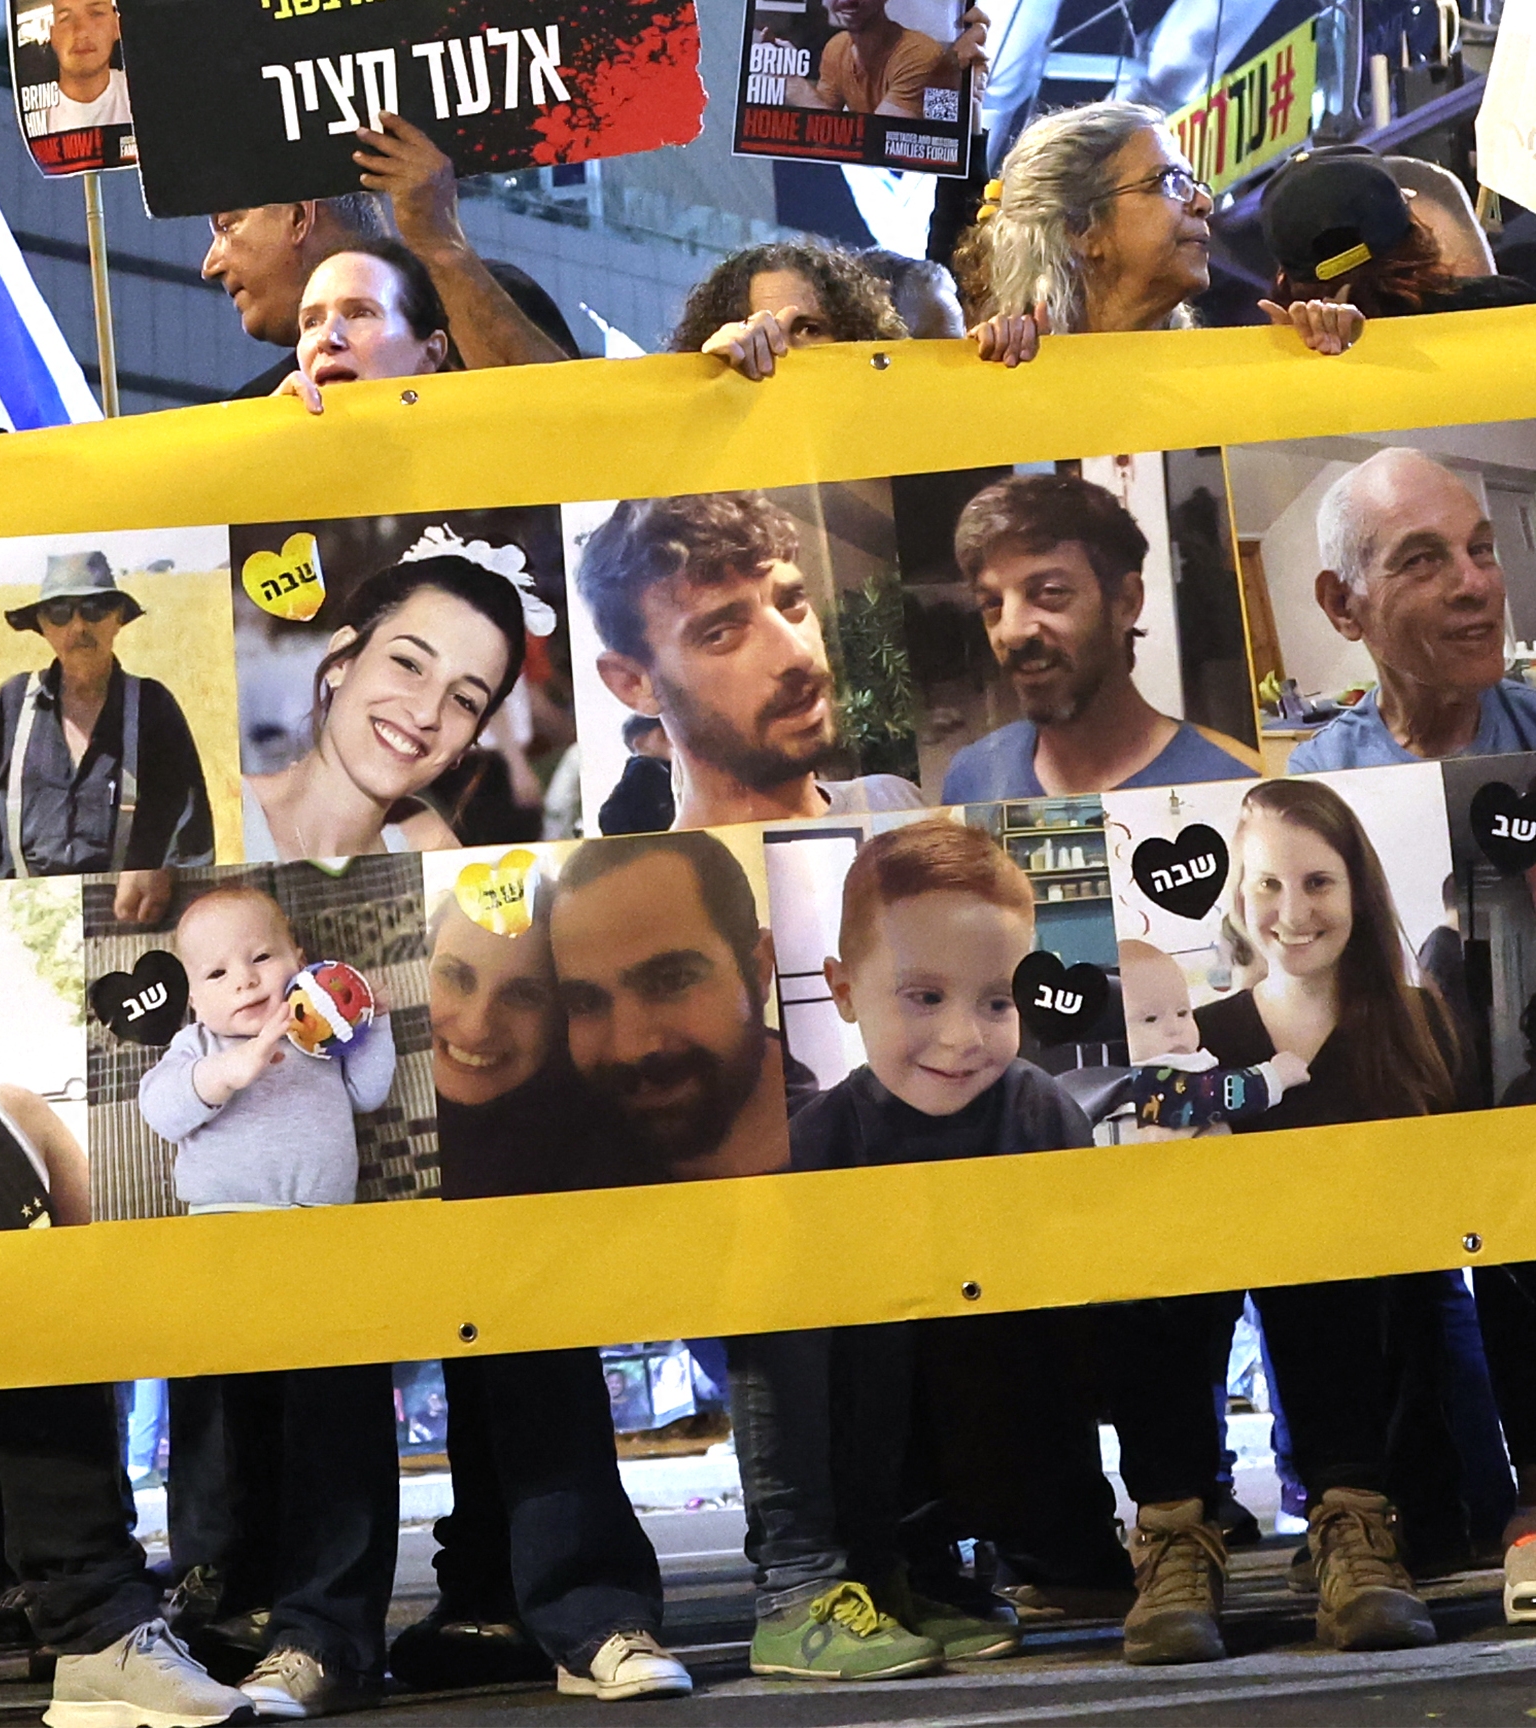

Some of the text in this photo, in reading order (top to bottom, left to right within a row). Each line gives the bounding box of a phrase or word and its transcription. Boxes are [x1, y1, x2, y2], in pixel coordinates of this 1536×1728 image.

[748, 42, 811, 77] BRING
[21, 80, 60, 112] BRING
[261, 25, 572, 141] אלעד קציר
[745, 74, 786, 106] HIM
[24, 109, 49, 139] HIM
[742, 107, 864, 147] HOME NOW!
[884, 141, 926, 160] FAMILIES
[926, 145, 959, 163] FORUM
[260, 562, 318, 602] שבה
[1151, 853, 1217, 894] שבה
[122, 981, 169, 1023] שב
[1033, 984, 1084, 1015] שב
